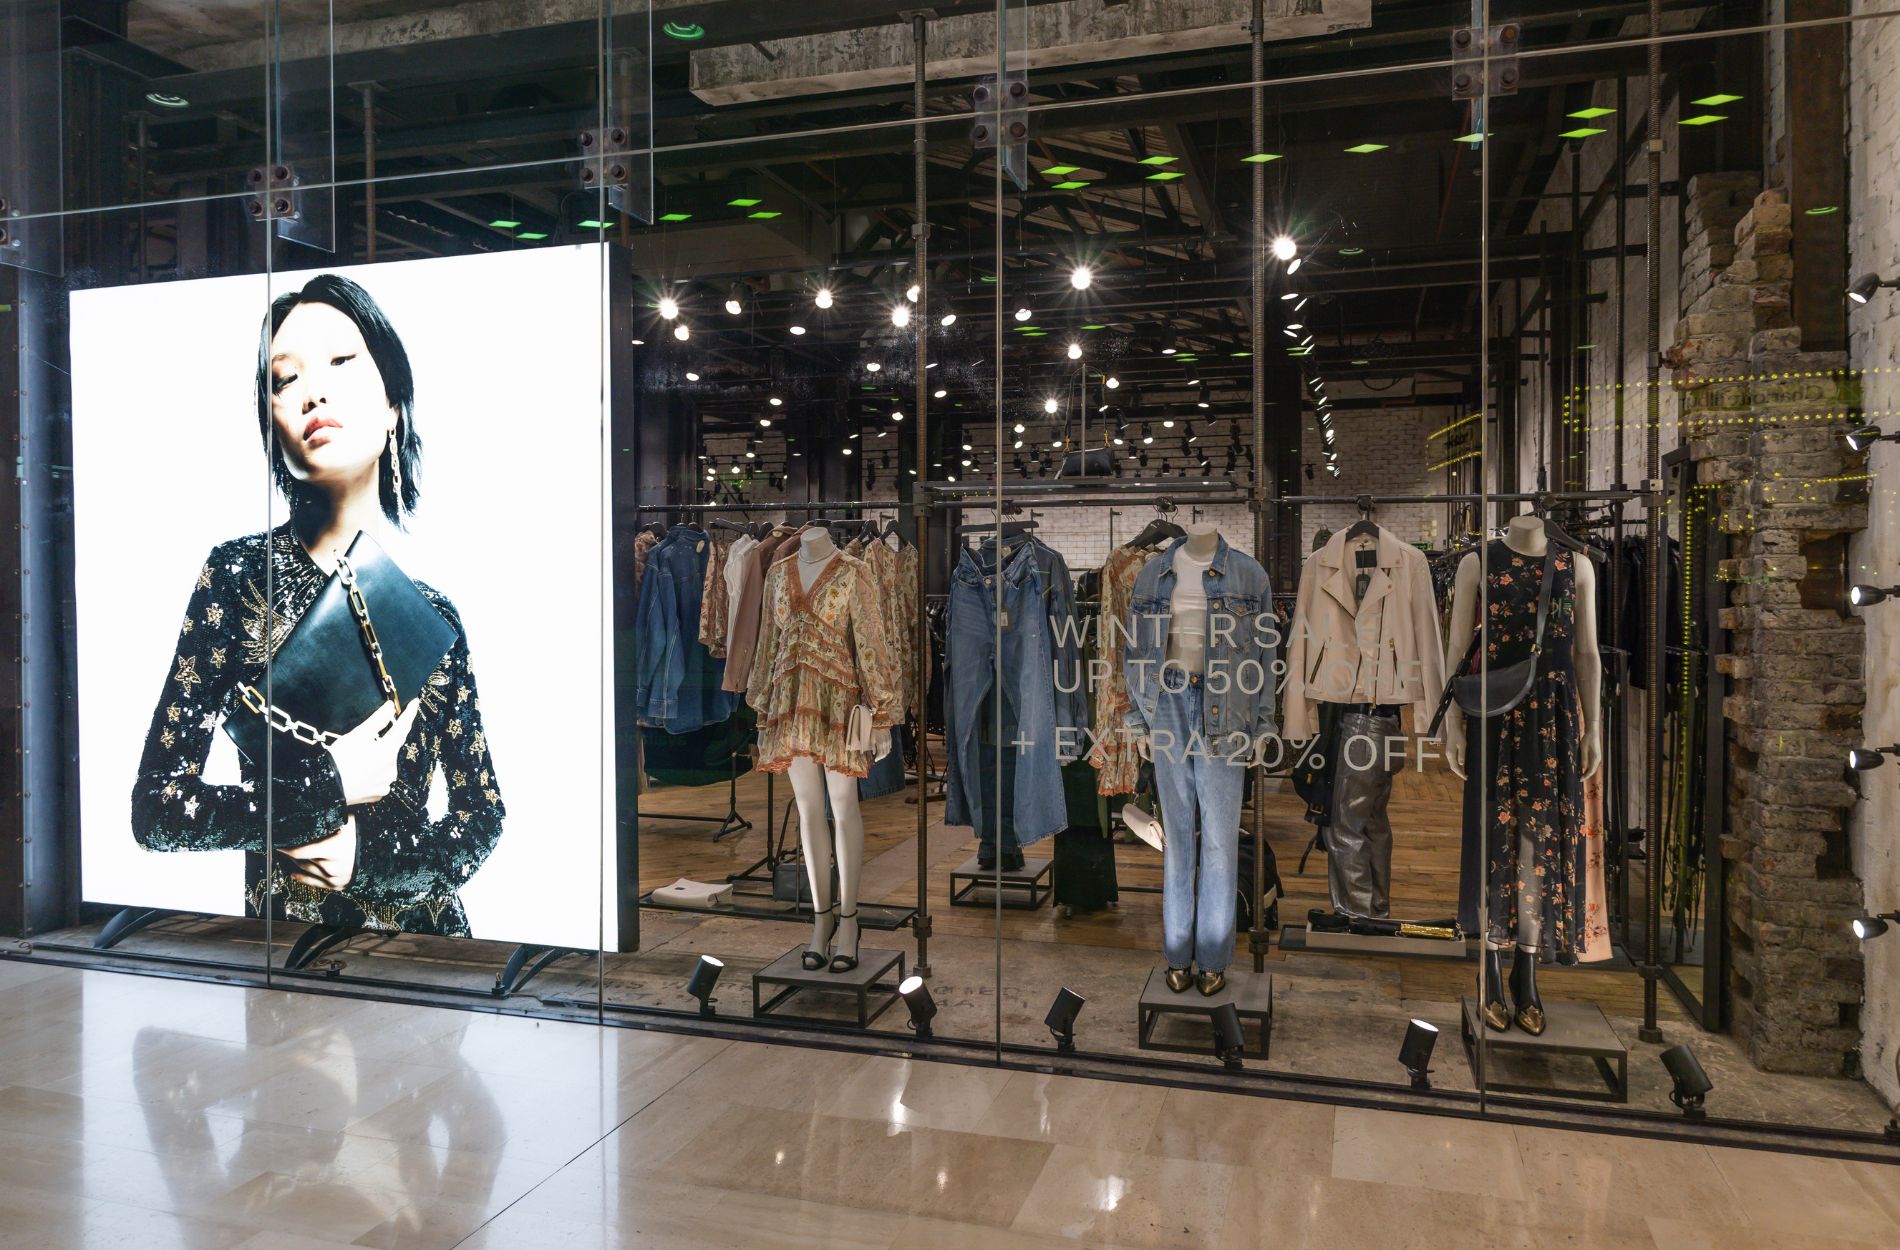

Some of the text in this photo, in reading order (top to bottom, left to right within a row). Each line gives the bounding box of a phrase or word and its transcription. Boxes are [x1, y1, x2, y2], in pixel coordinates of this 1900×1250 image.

[1049, 612, 1381, 649] WINTER SALE
[1053, 659, 1113, 693] UP
[1127, 658, 1190, 694] TO
[1206, 658, 1306, 695] 50%
[1011, 726, 1442, 773] + EXTRA 20% OFF
